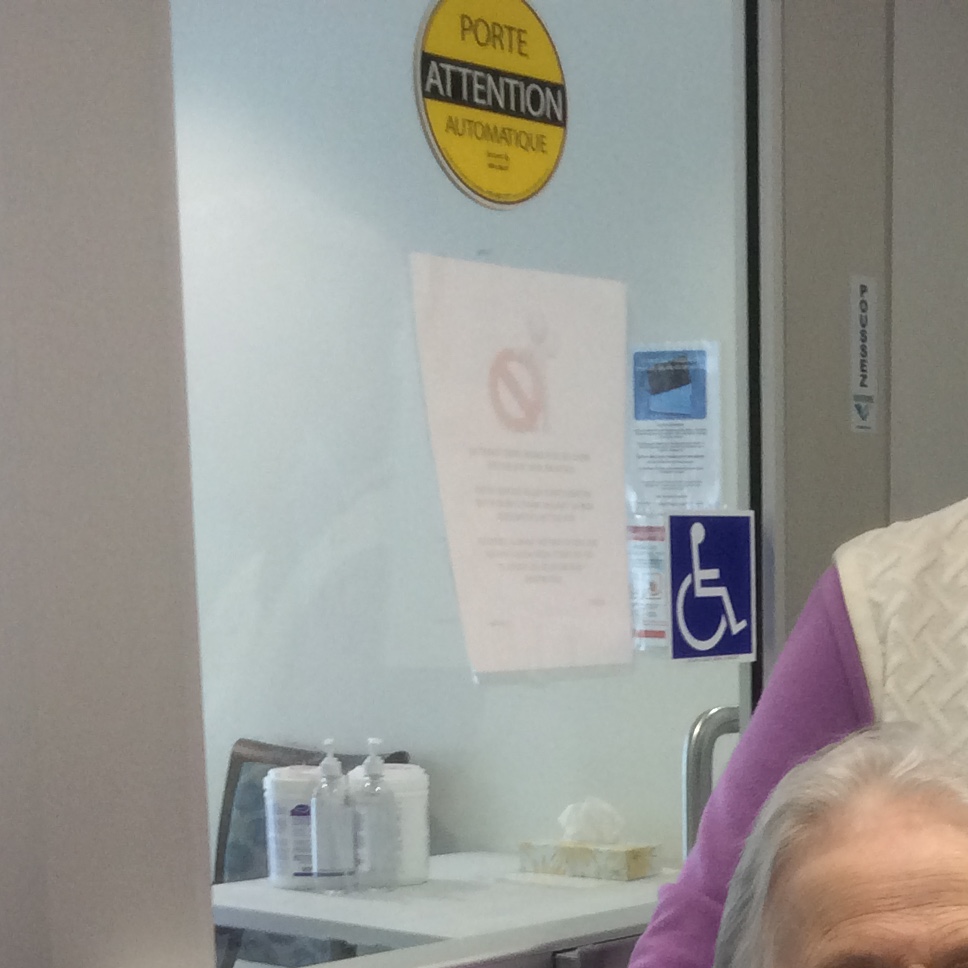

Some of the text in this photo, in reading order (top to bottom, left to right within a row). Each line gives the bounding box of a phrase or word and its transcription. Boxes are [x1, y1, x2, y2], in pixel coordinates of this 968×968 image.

[460, 14, 528, 57] PORTE
[425, 60, 565, 123] ATTENTION
[445, 115, 548, 153] AUTOMATIQUE
[859, 284, 869, 388] POUSSEZ
